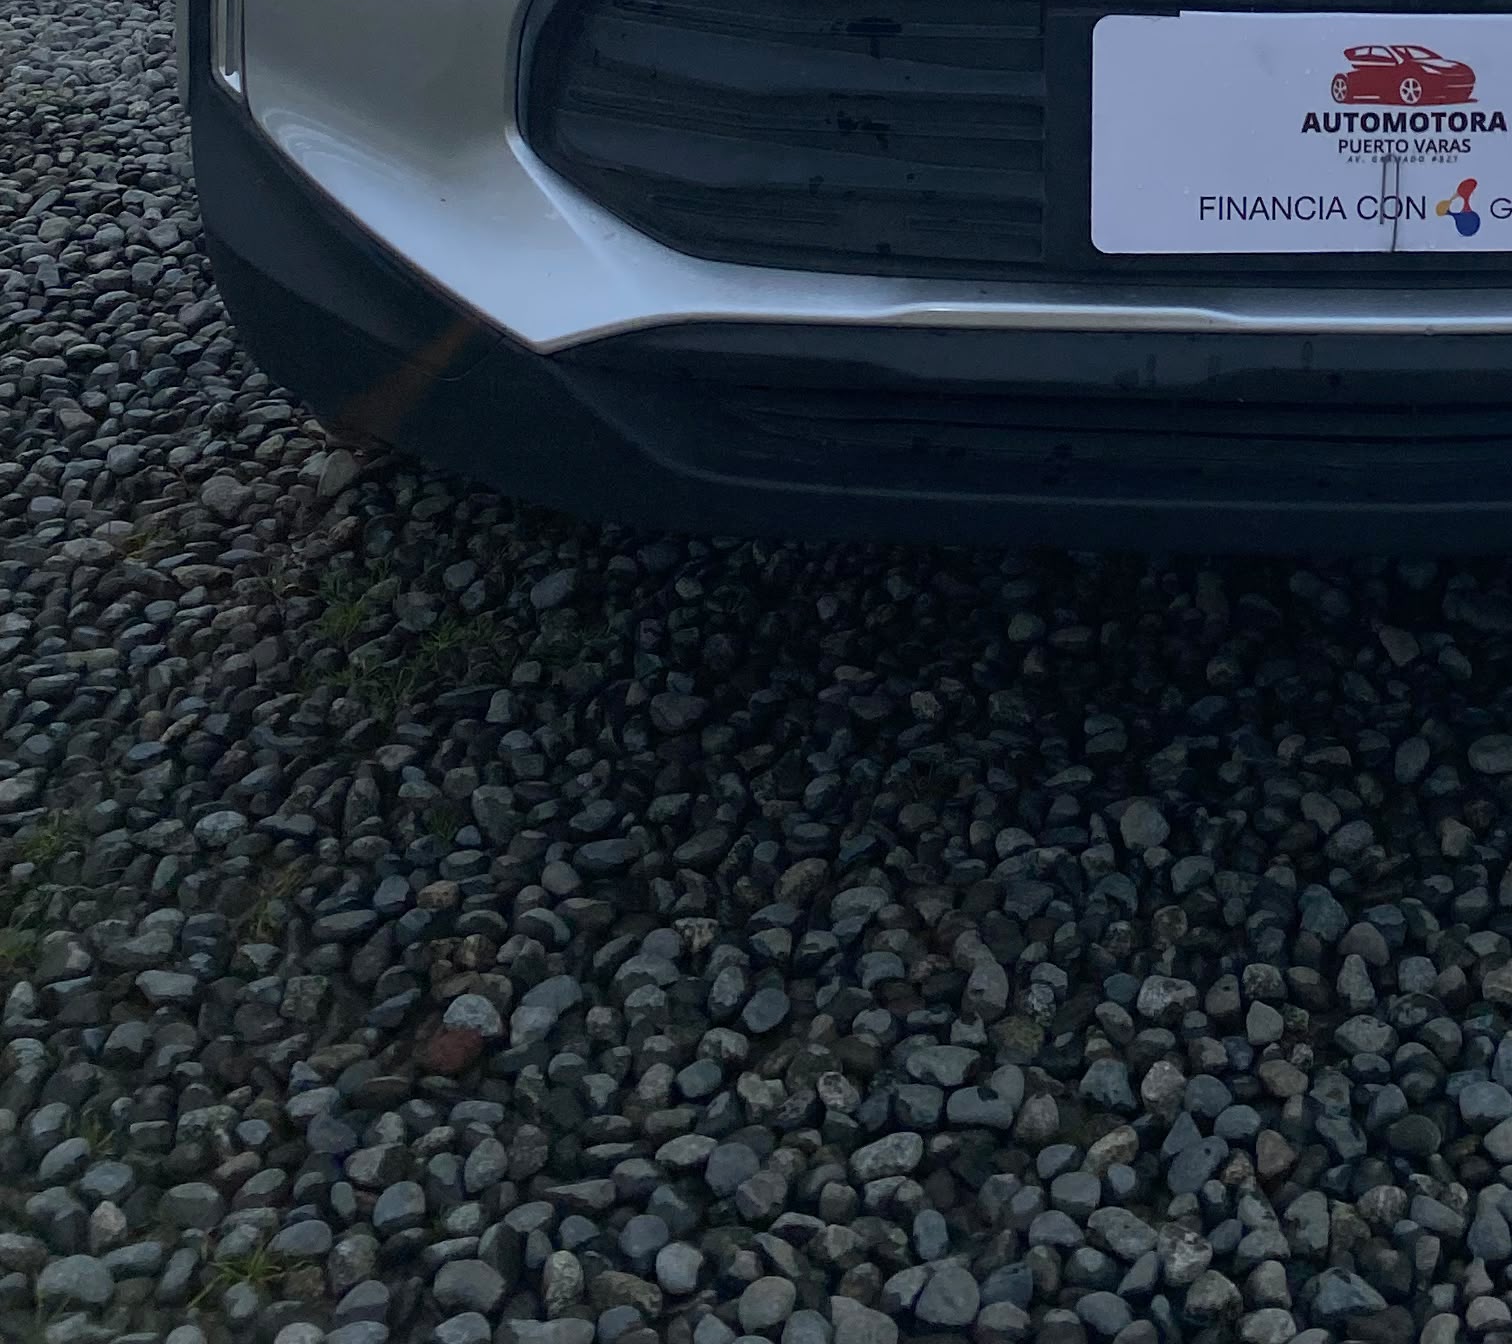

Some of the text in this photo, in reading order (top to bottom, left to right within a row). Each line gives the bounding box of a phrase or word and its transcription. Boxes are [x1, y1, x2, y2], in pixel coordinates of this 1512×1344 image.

[1301, 111, 1508, 134] AUTOMOTORA
[1338, 138, 1472, 154] PUERTO VARAS
[1199, 195, 1348, 221] FINANCIA
[1356, 195, 1427, 220] CON
